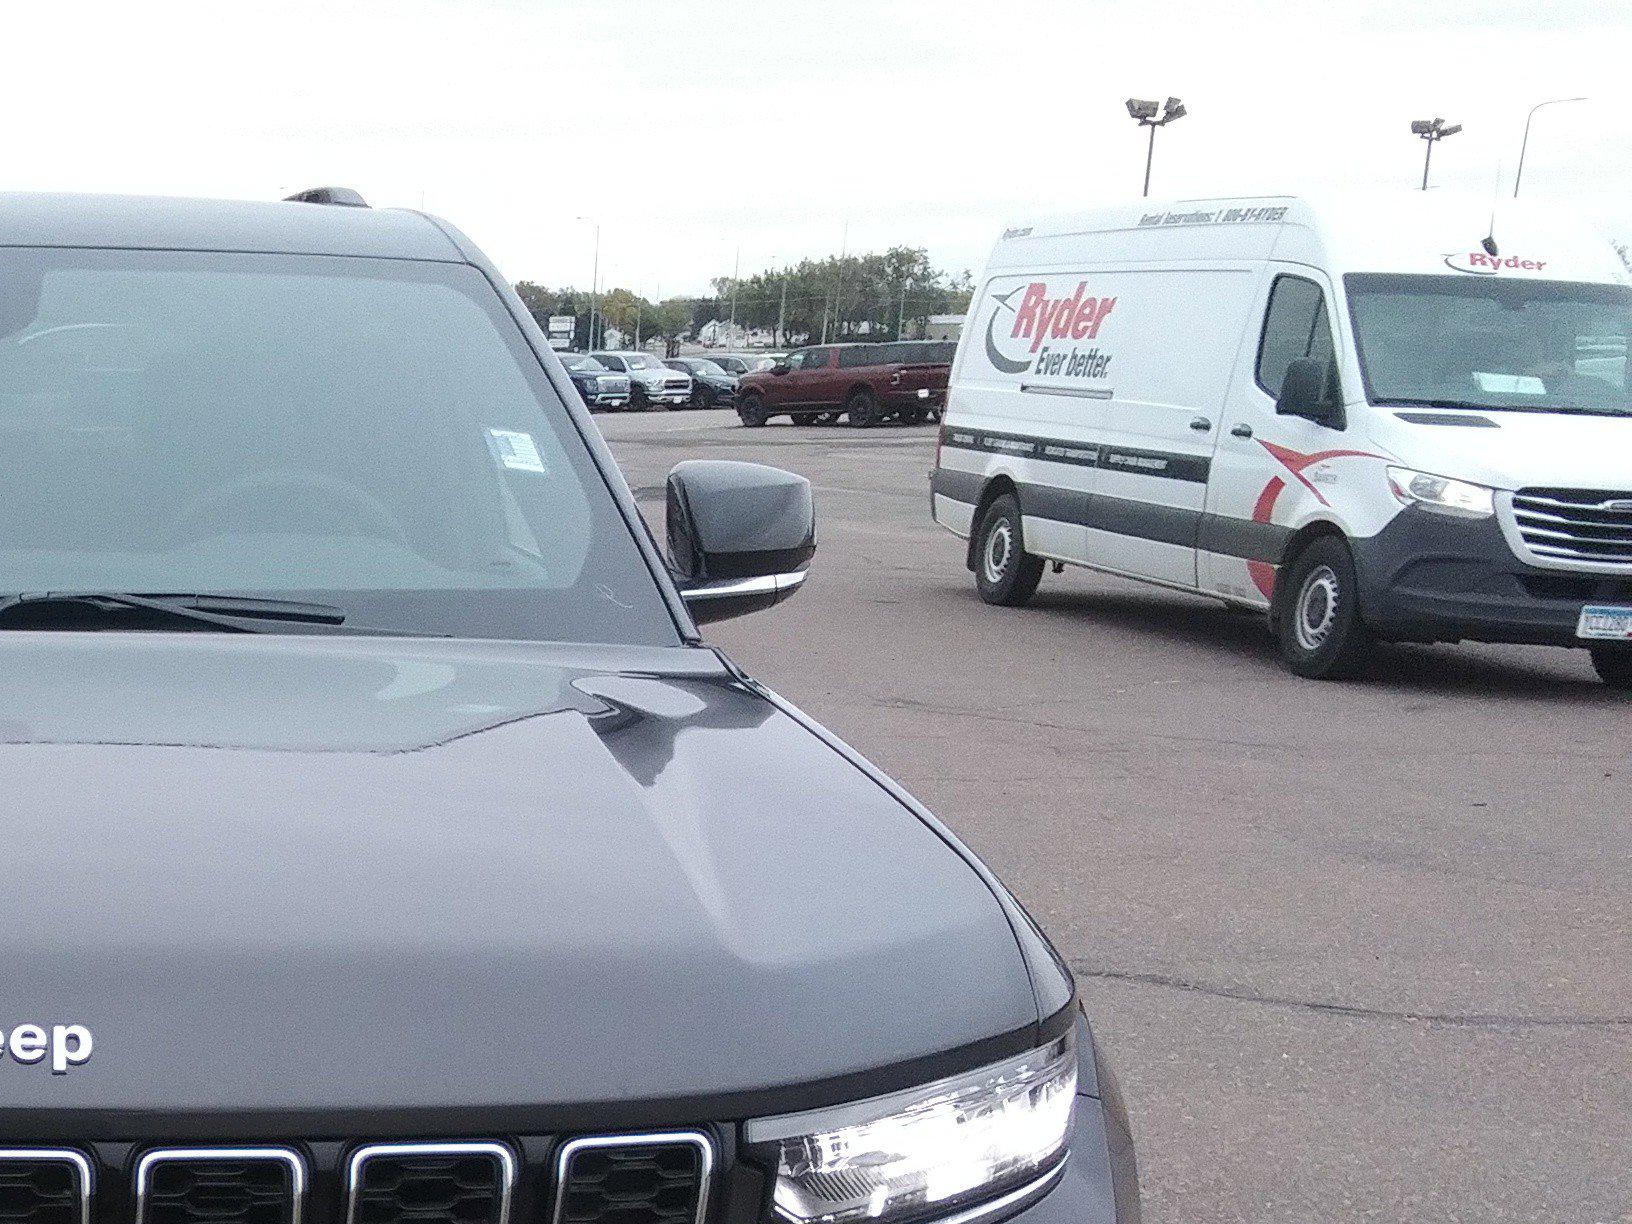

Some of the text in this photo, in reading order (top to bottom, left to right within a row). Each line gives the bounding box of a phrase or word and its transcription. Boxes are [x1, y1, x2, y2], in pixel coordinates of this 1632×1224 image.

[1469, 253, 1547, 271] Ryder
[1010, 281, 1118, 354] Ryder
[1035, 346, 1112, 378] Ever better.
